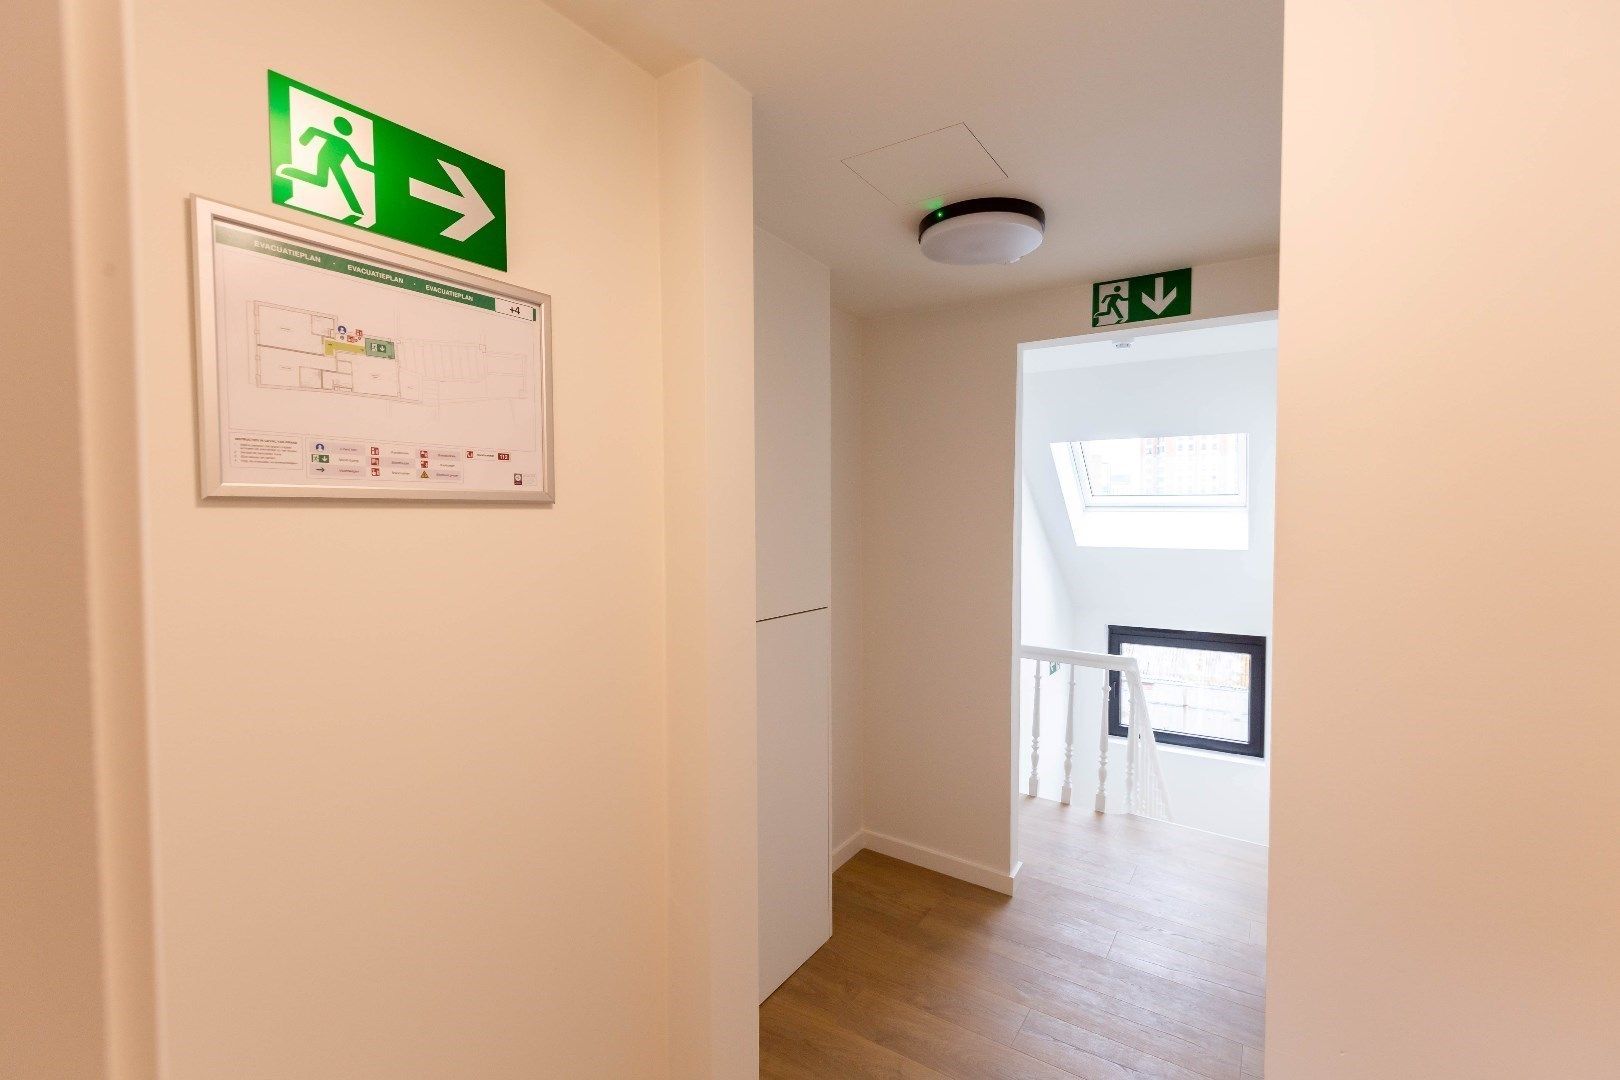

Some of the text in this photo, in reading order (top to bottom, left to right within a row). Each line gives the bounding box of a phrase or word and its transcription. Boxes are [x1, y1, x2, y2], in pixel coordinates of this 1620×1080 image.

[254, 240, 474, 302] EVACUATIEPLAN EVACUATIEPLAN EVACUATIEPLAN
[509, 306, 521, 315] +4
